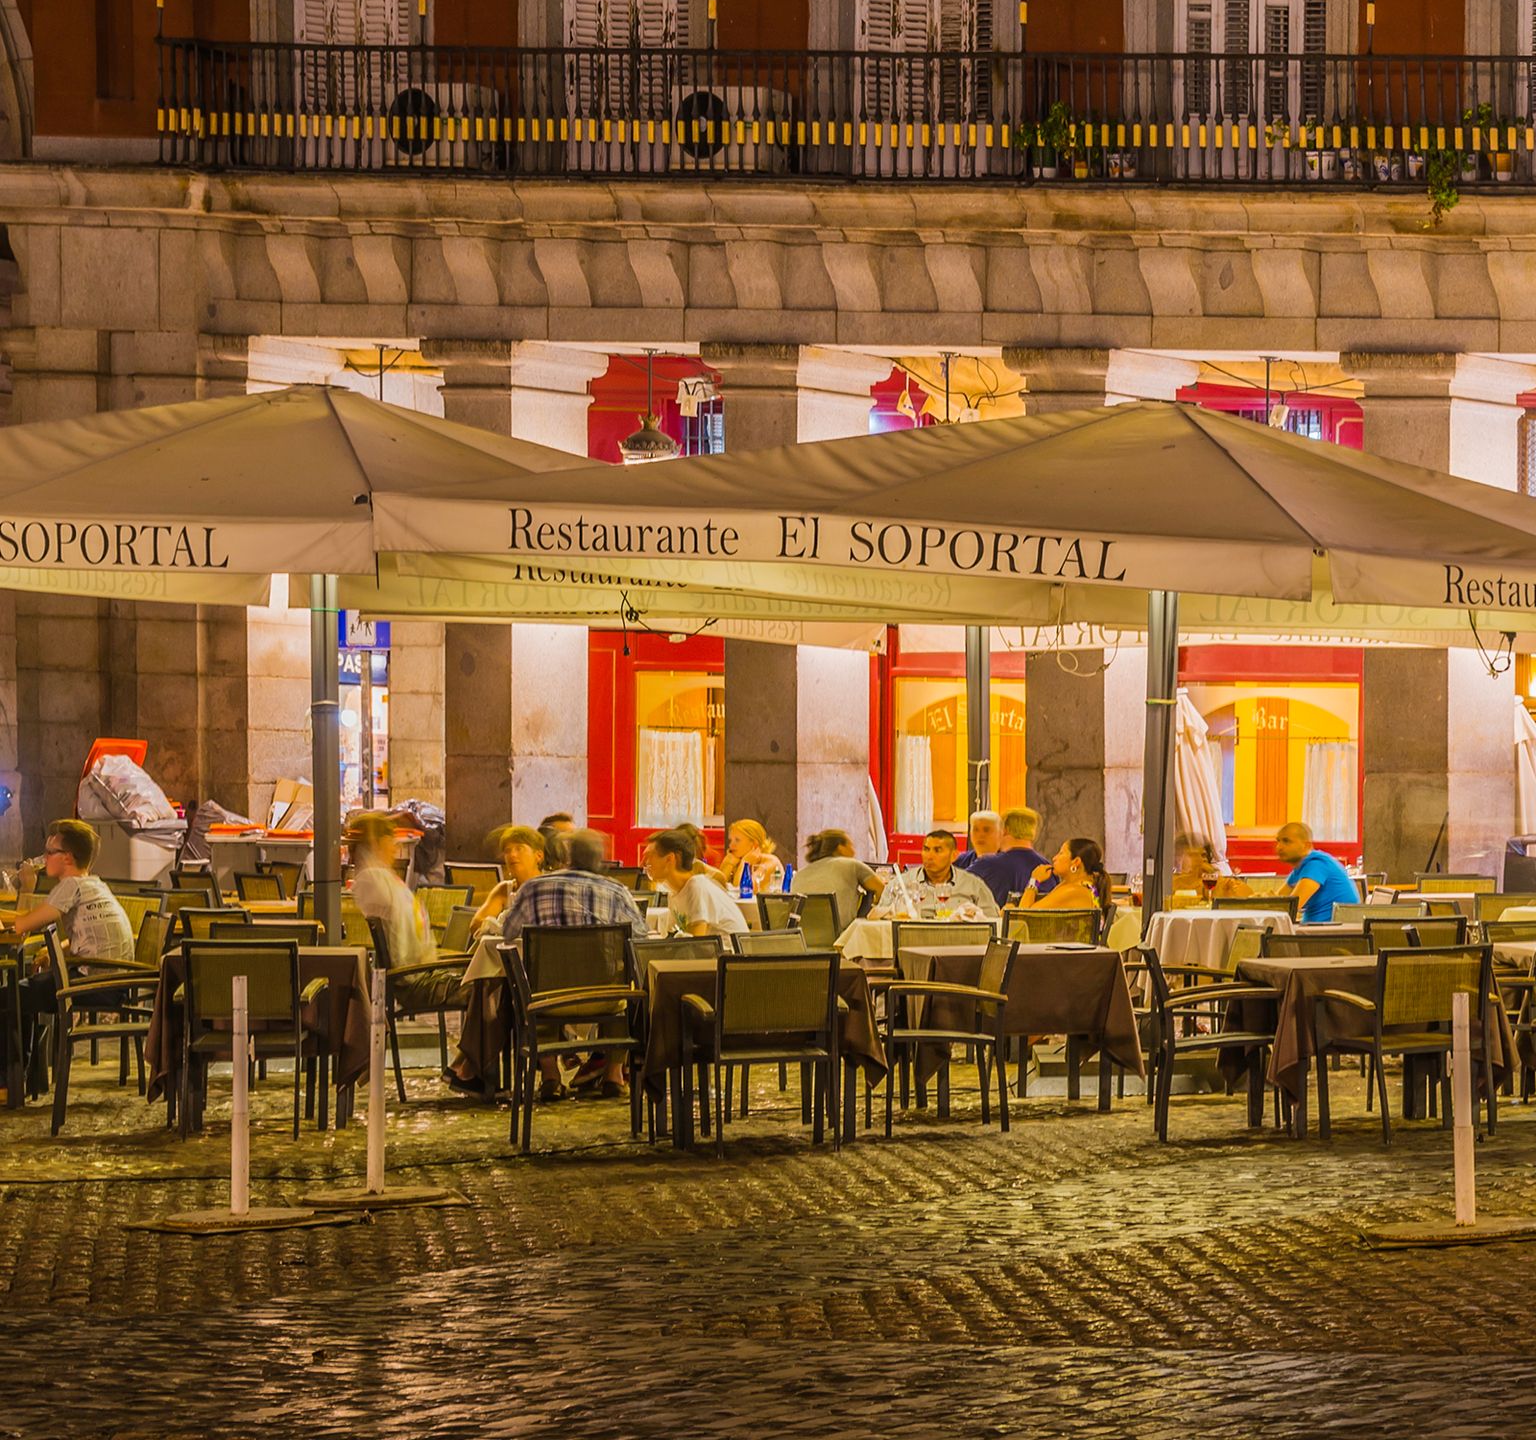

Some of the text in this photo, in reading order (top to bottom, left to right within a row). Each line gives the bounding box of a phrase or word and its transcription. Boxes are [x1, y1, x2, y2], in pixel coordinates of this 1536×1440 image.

[508, 507, 1127, 582] Restaurante El SOPORTAL
[1252, 707, 1289, 731] Bar
